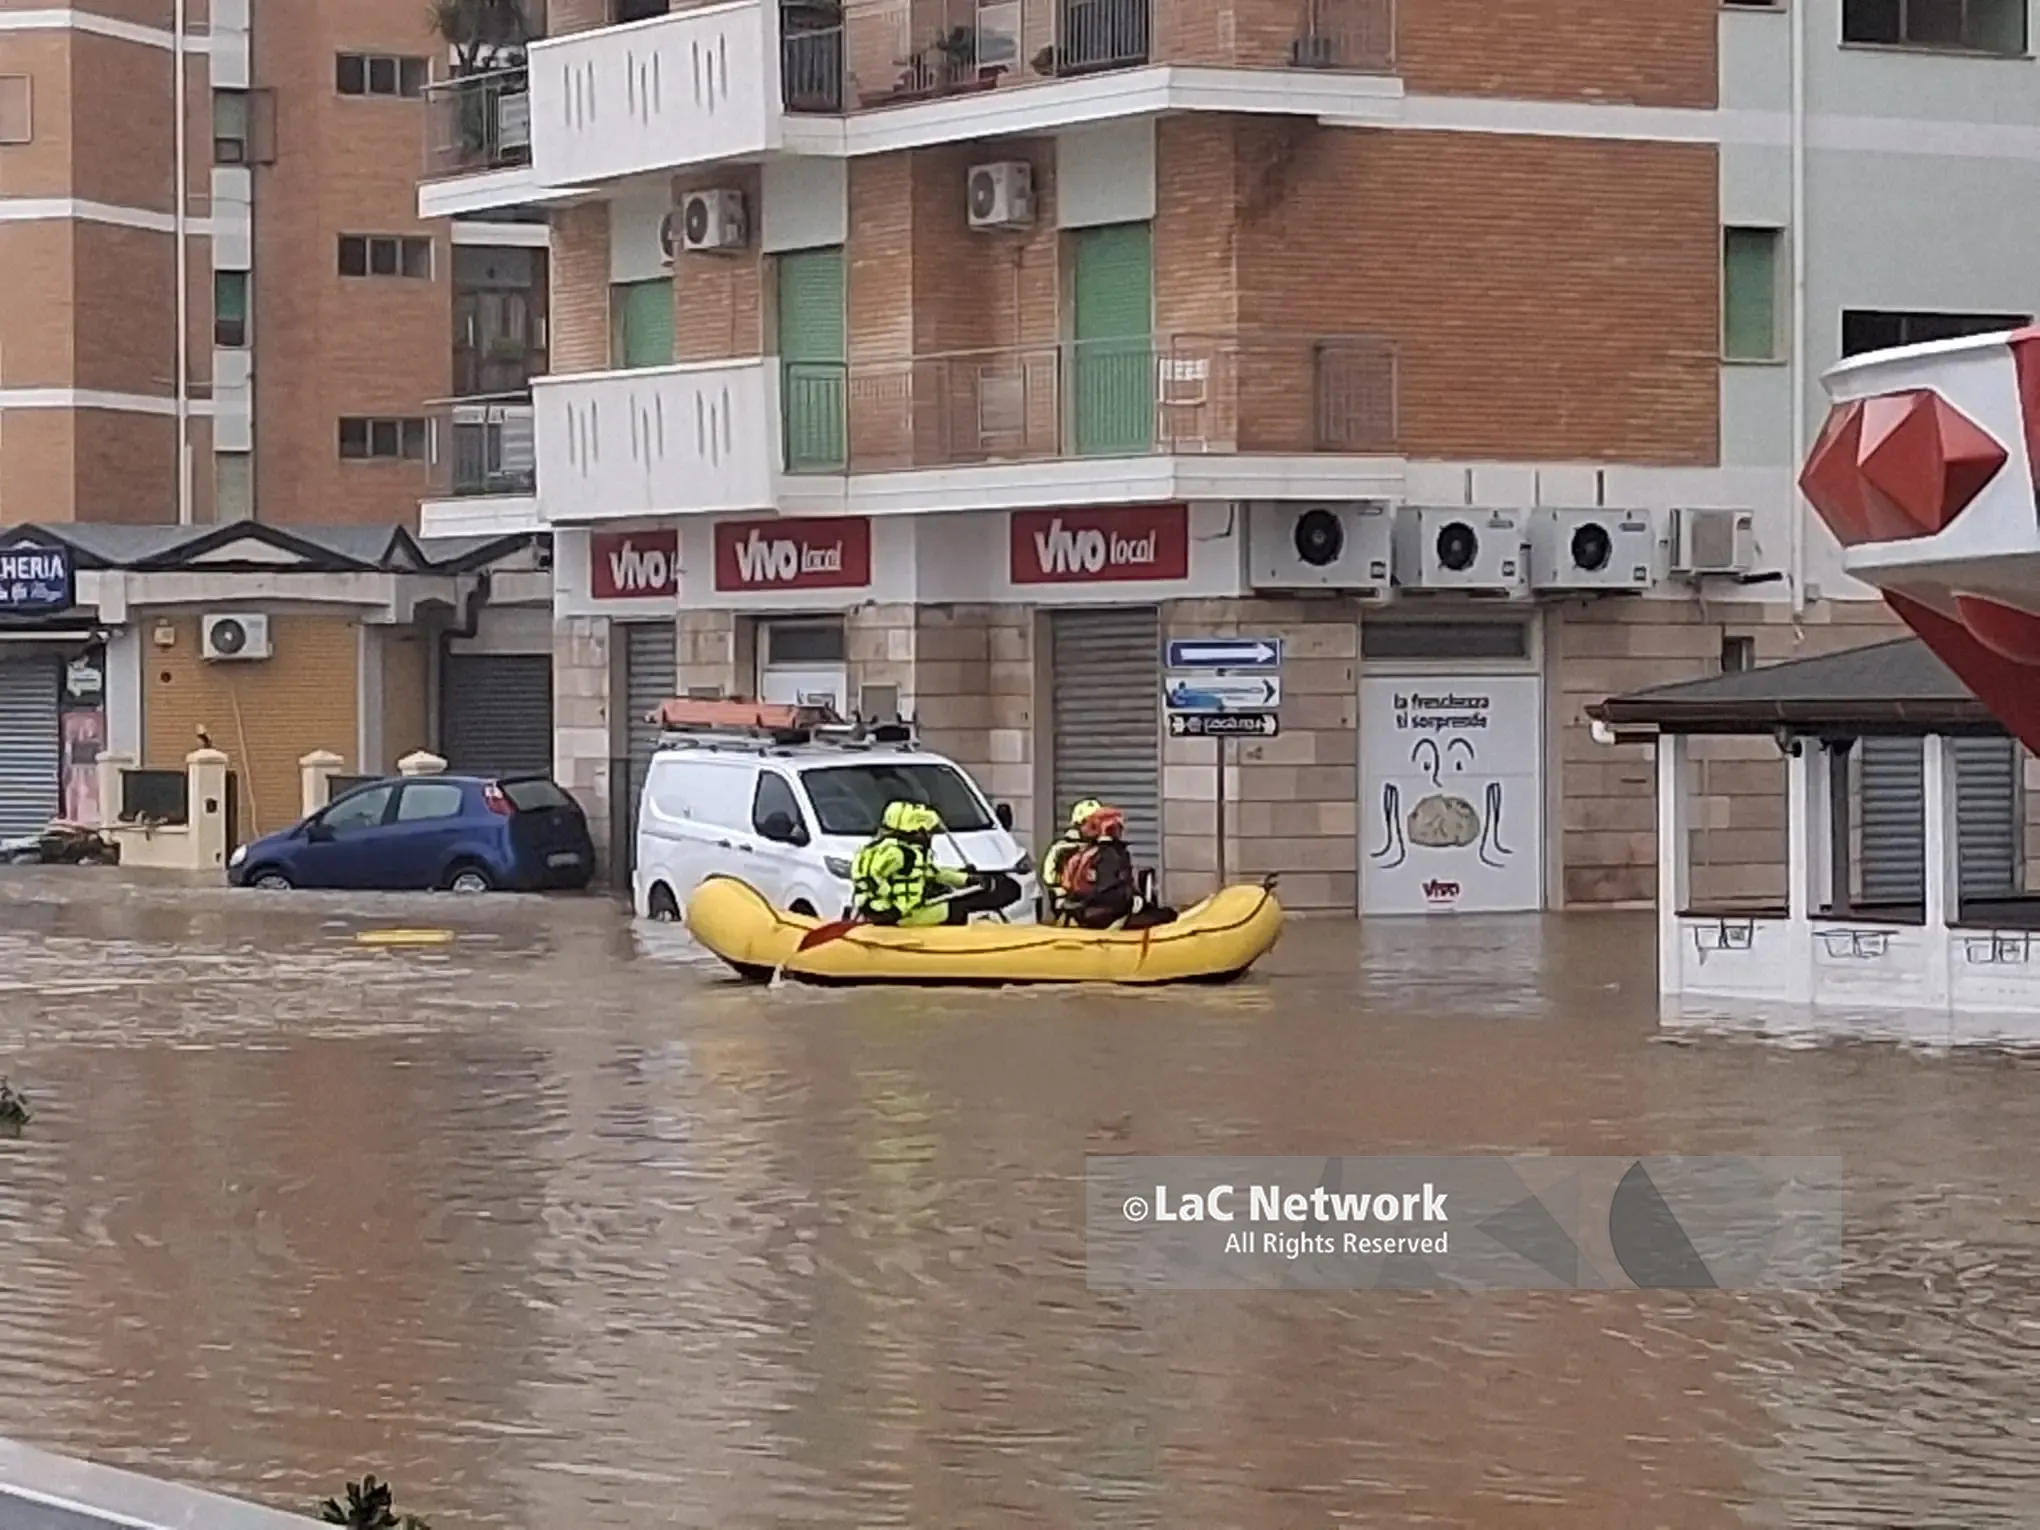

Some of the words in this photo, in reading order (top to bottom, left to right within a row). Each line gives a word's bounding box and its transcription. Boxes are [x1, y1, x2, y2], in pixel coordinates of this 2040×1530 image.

[801, 540, 843, 573] local
[1110, 529, 1157, 565] local
[0, 554, 64, 581] HERIA
